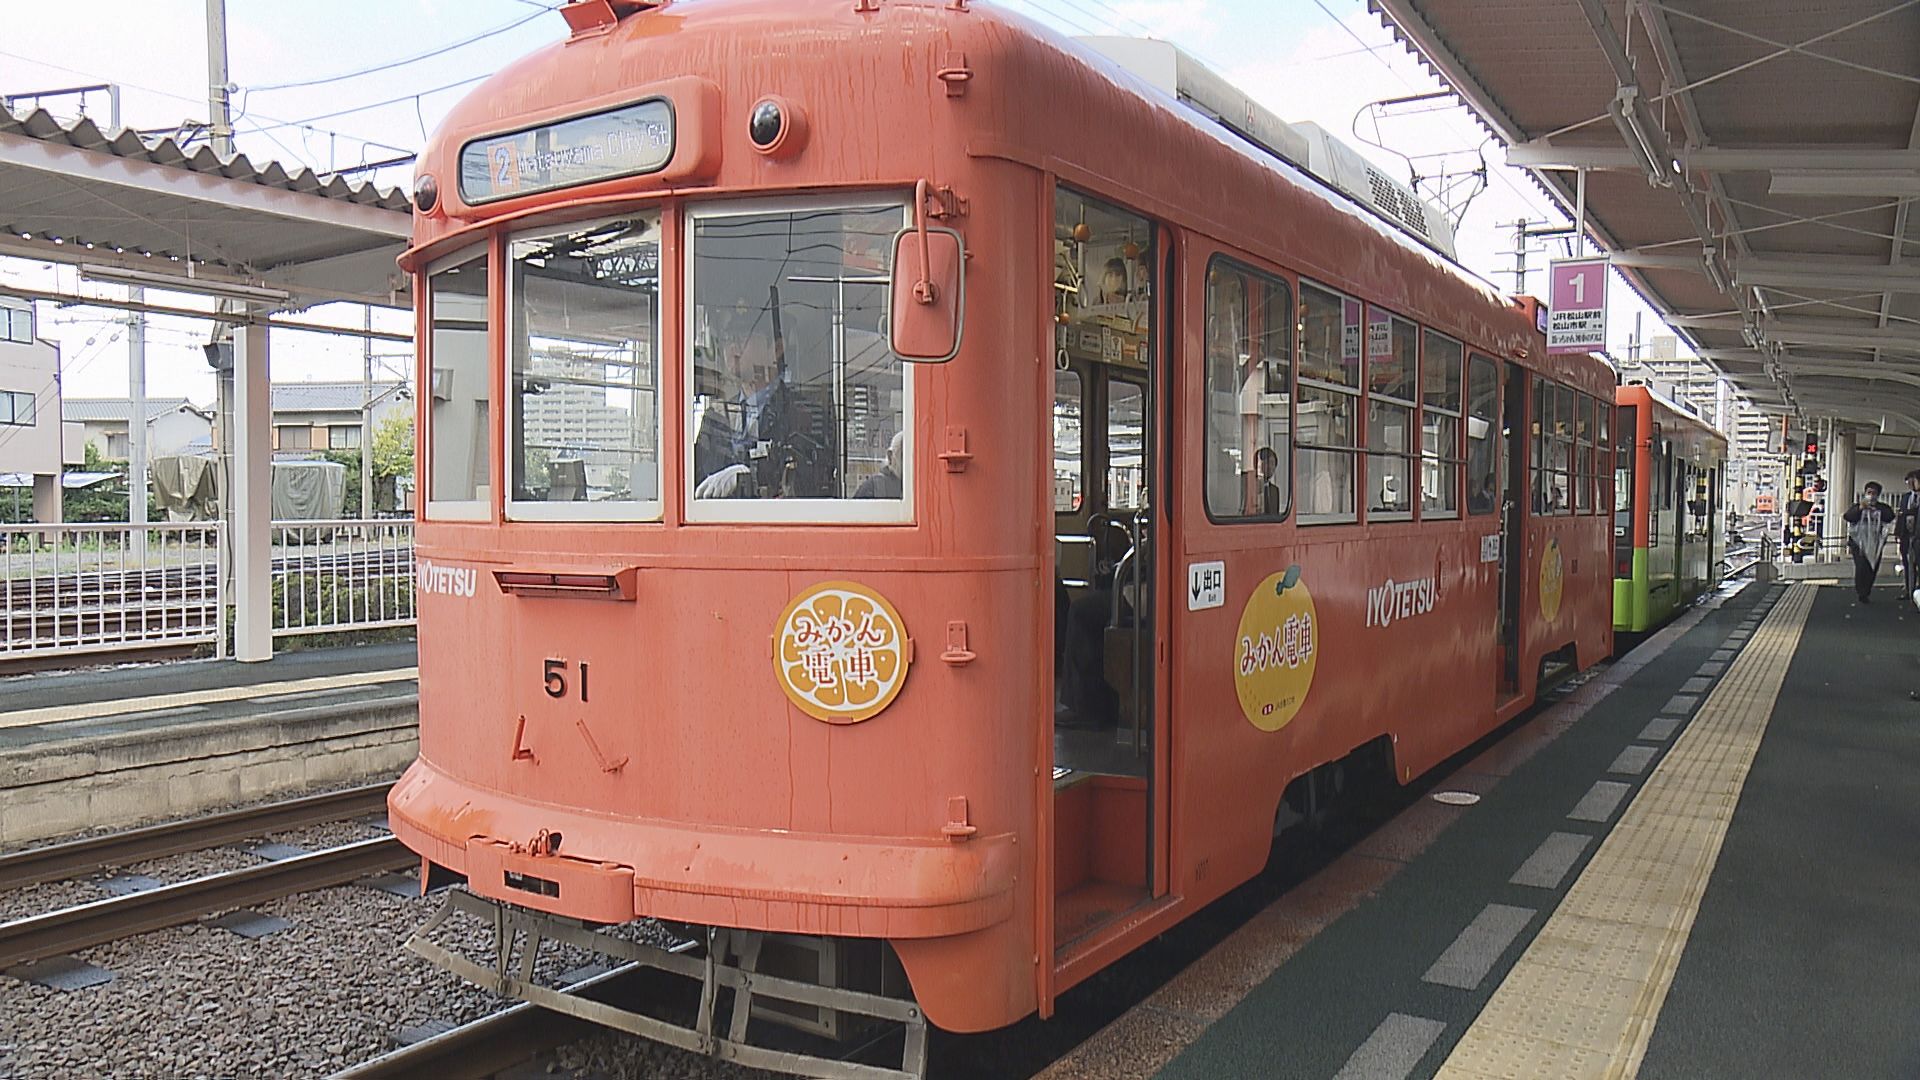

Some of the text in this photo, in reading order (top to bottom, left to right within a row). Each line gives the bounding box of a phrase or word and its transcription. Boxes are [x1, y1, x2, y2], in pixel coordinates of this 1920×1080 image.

[494, 147, 513, 186] 2
[1568, 272, 1585, 303] 1
[1552, 311, 1601, 321] JR松山駅前
[1552, 321, 1587, 331] 松山市駅
[417, 559, 477, 598] IYOTETSU
[1203, 569, 1221, 591] 出口
[1366, 577, 1436, 628] IYOTETSU
[795, 616, 884, 645] みかん
[1240, 613, 1313, 676] みかん電車
[543, 658, 590, 703] 51
[801, 648, 877, 686] 電車
